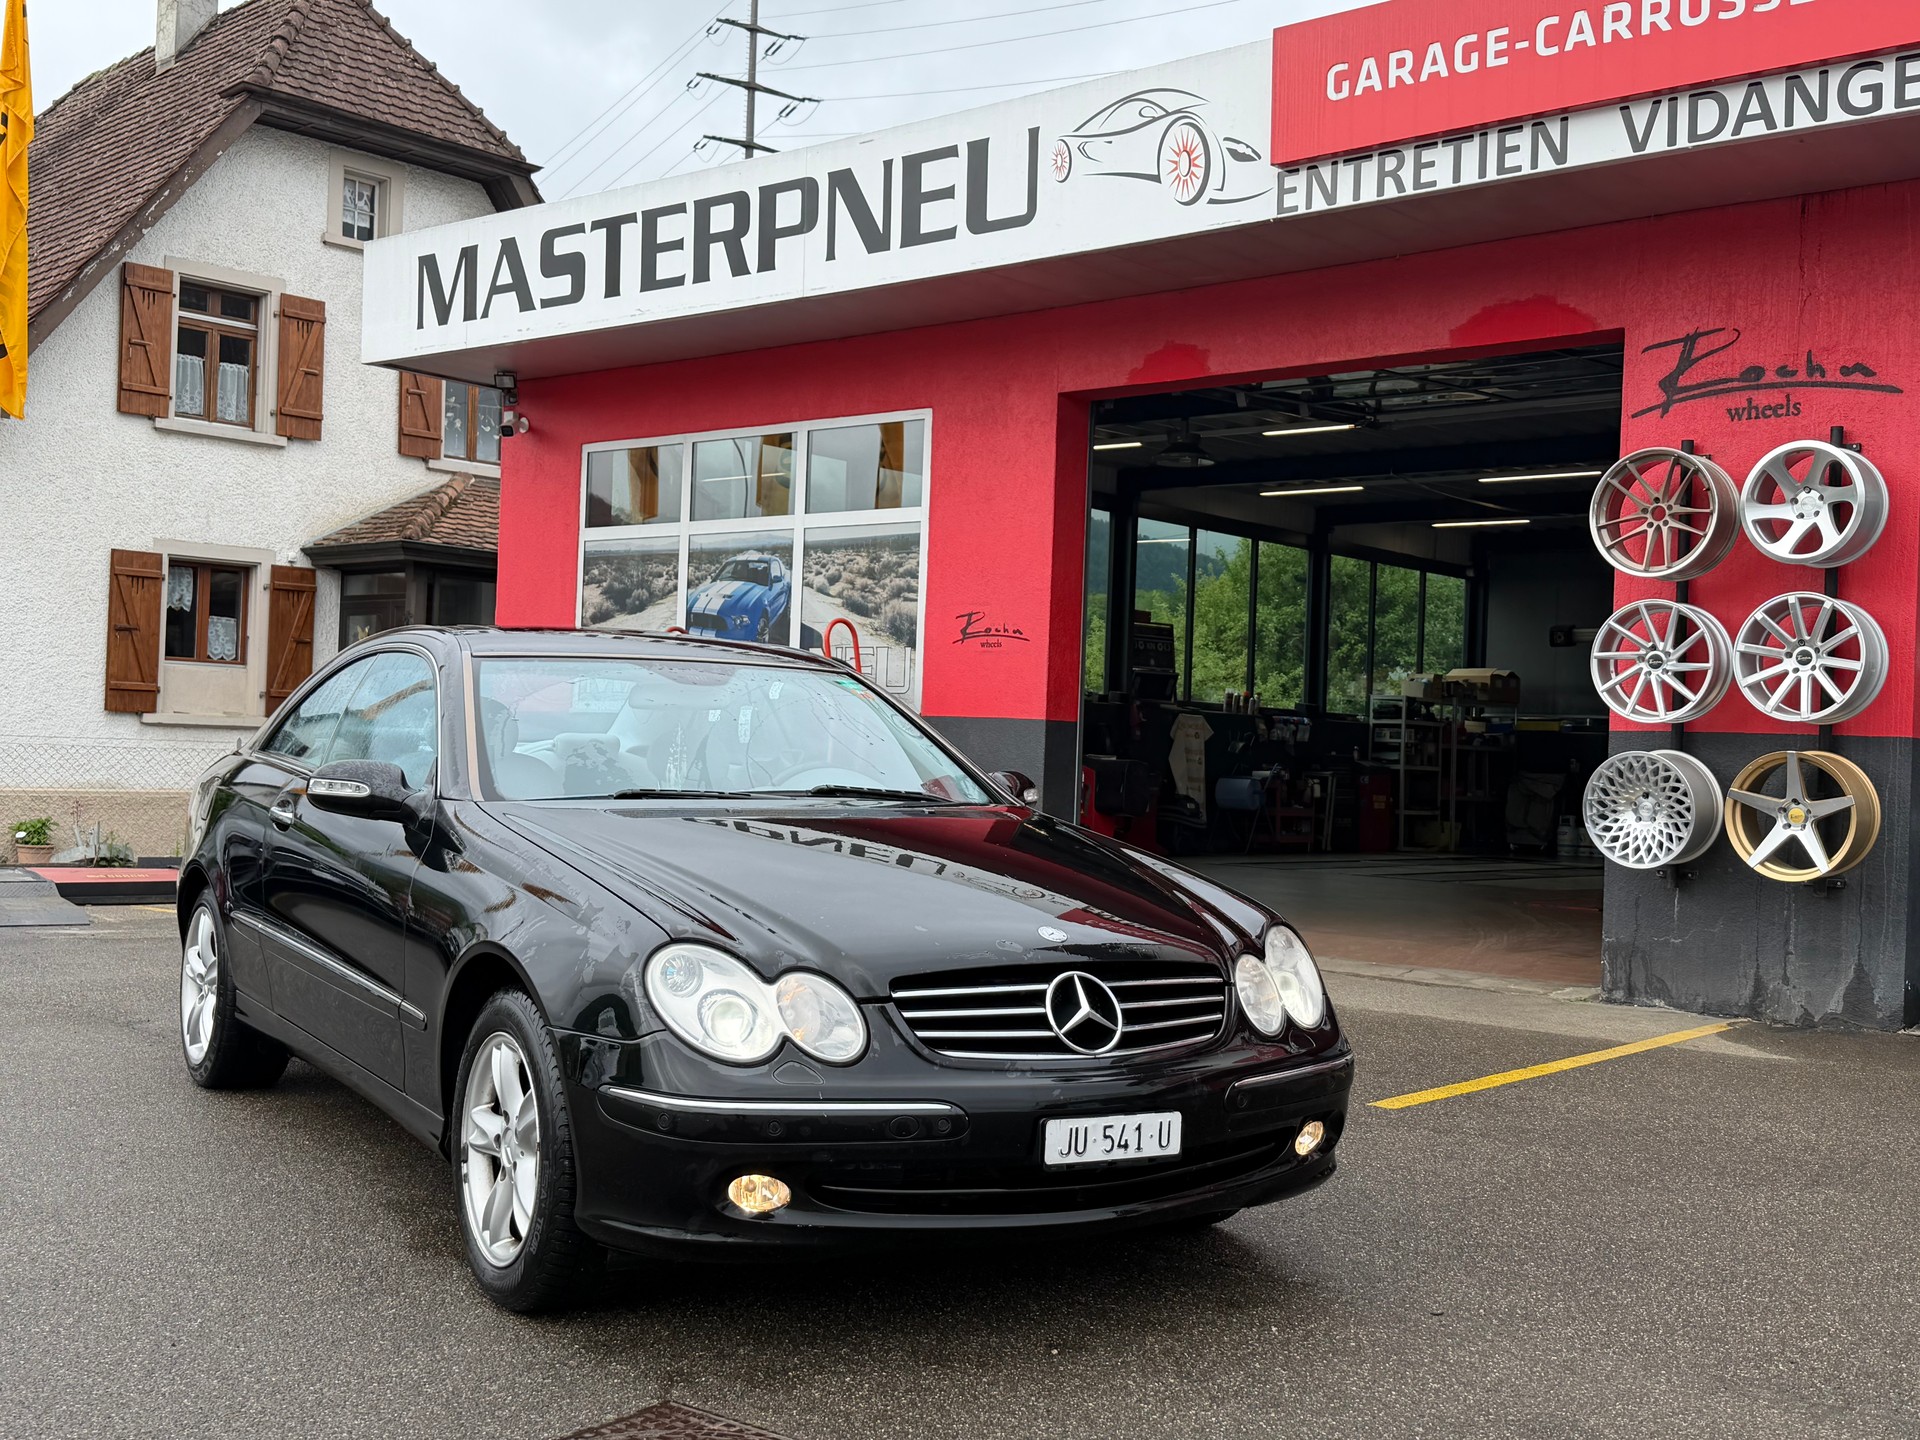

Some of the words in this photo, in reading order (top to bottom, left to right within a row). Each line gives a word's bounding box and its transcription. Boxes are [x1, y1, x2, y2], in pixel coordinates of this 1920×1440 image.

[1277, 117, 1570, 215] ENTRETIEN
[1620, 53, 1920, 153] VIDANGE
[417, 126, 1041, 330] MASTERPNEU
[1727, 395, 1802, 421] wheels
[980, 639, 1002, 648] wheels
[1058, 1126, 1088, 1157] JU
[1101, 1122, 1143, 1155] 541
[1158, 1119, 1171, 1150] U
